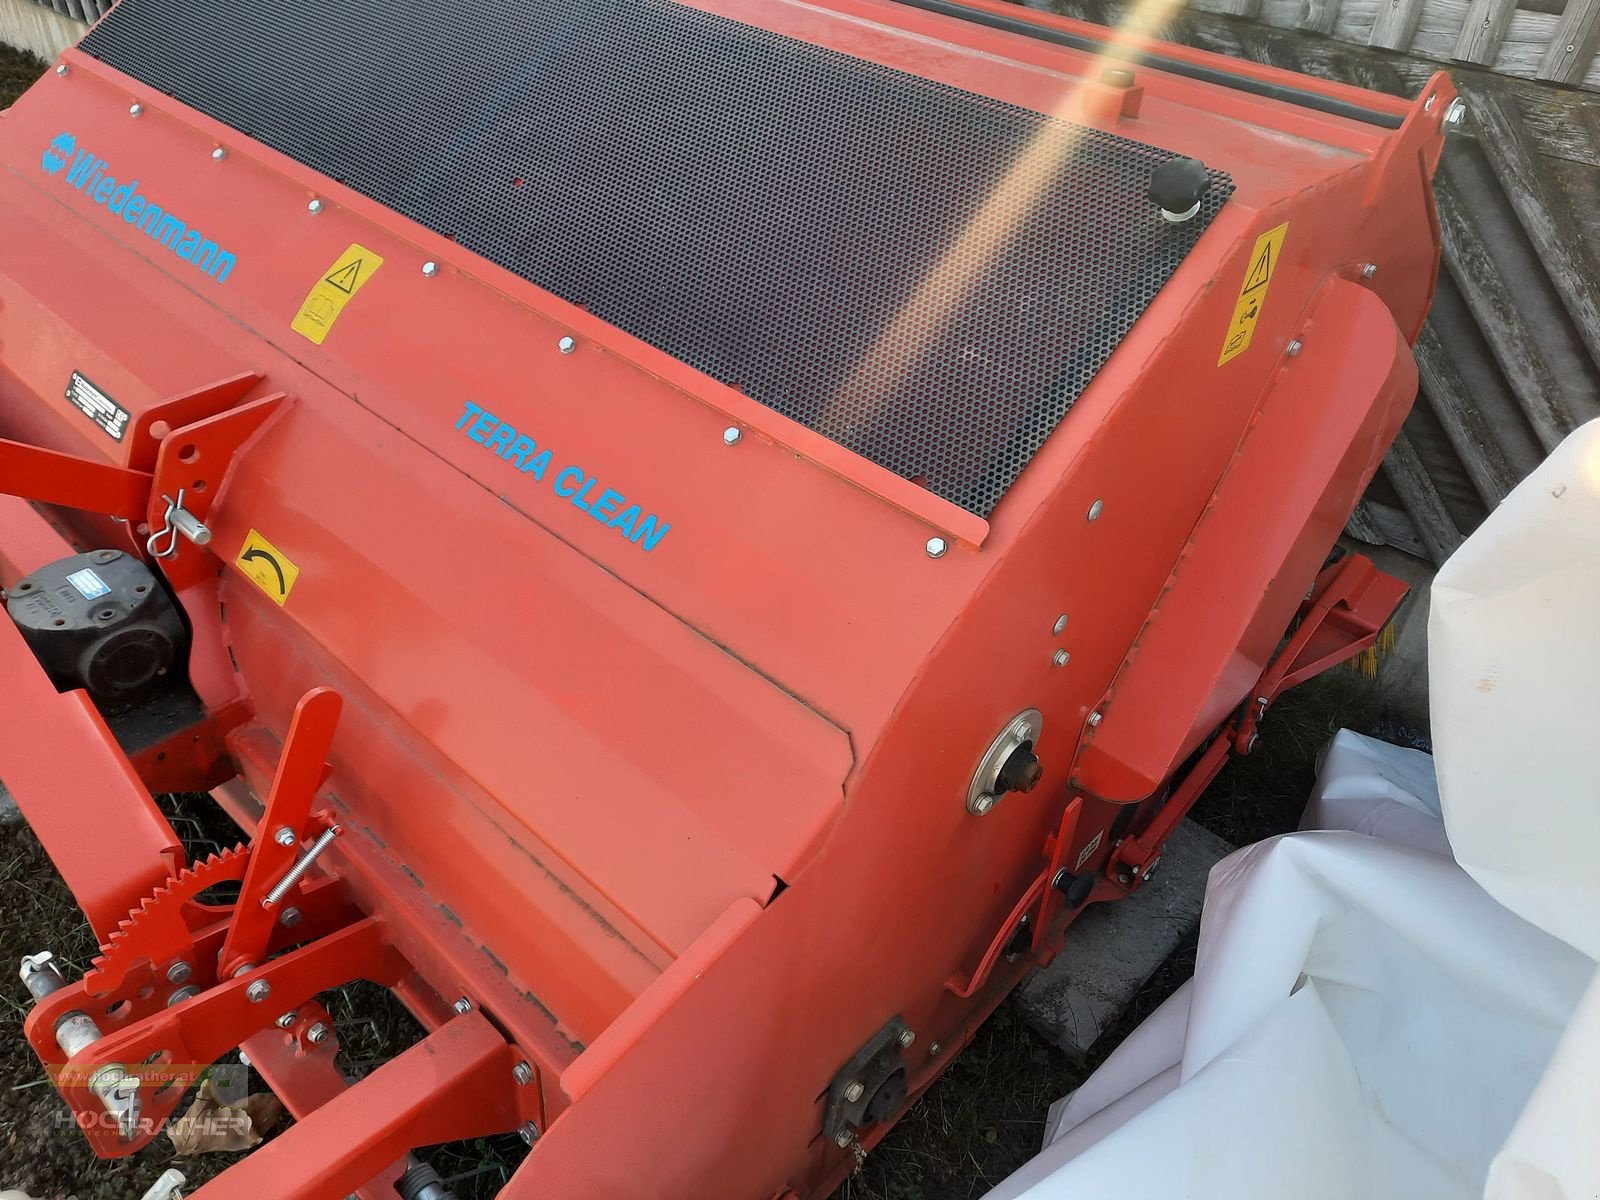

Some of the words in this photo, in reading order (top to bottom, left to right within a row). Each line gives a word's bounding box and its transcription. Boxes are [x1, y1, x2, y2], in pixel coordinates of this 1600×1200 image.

[66, 148, 237, 283] Wiedenmann
[454, 401, 553, 481] TERRA
[553, 466, 671, 552] CLEAN
